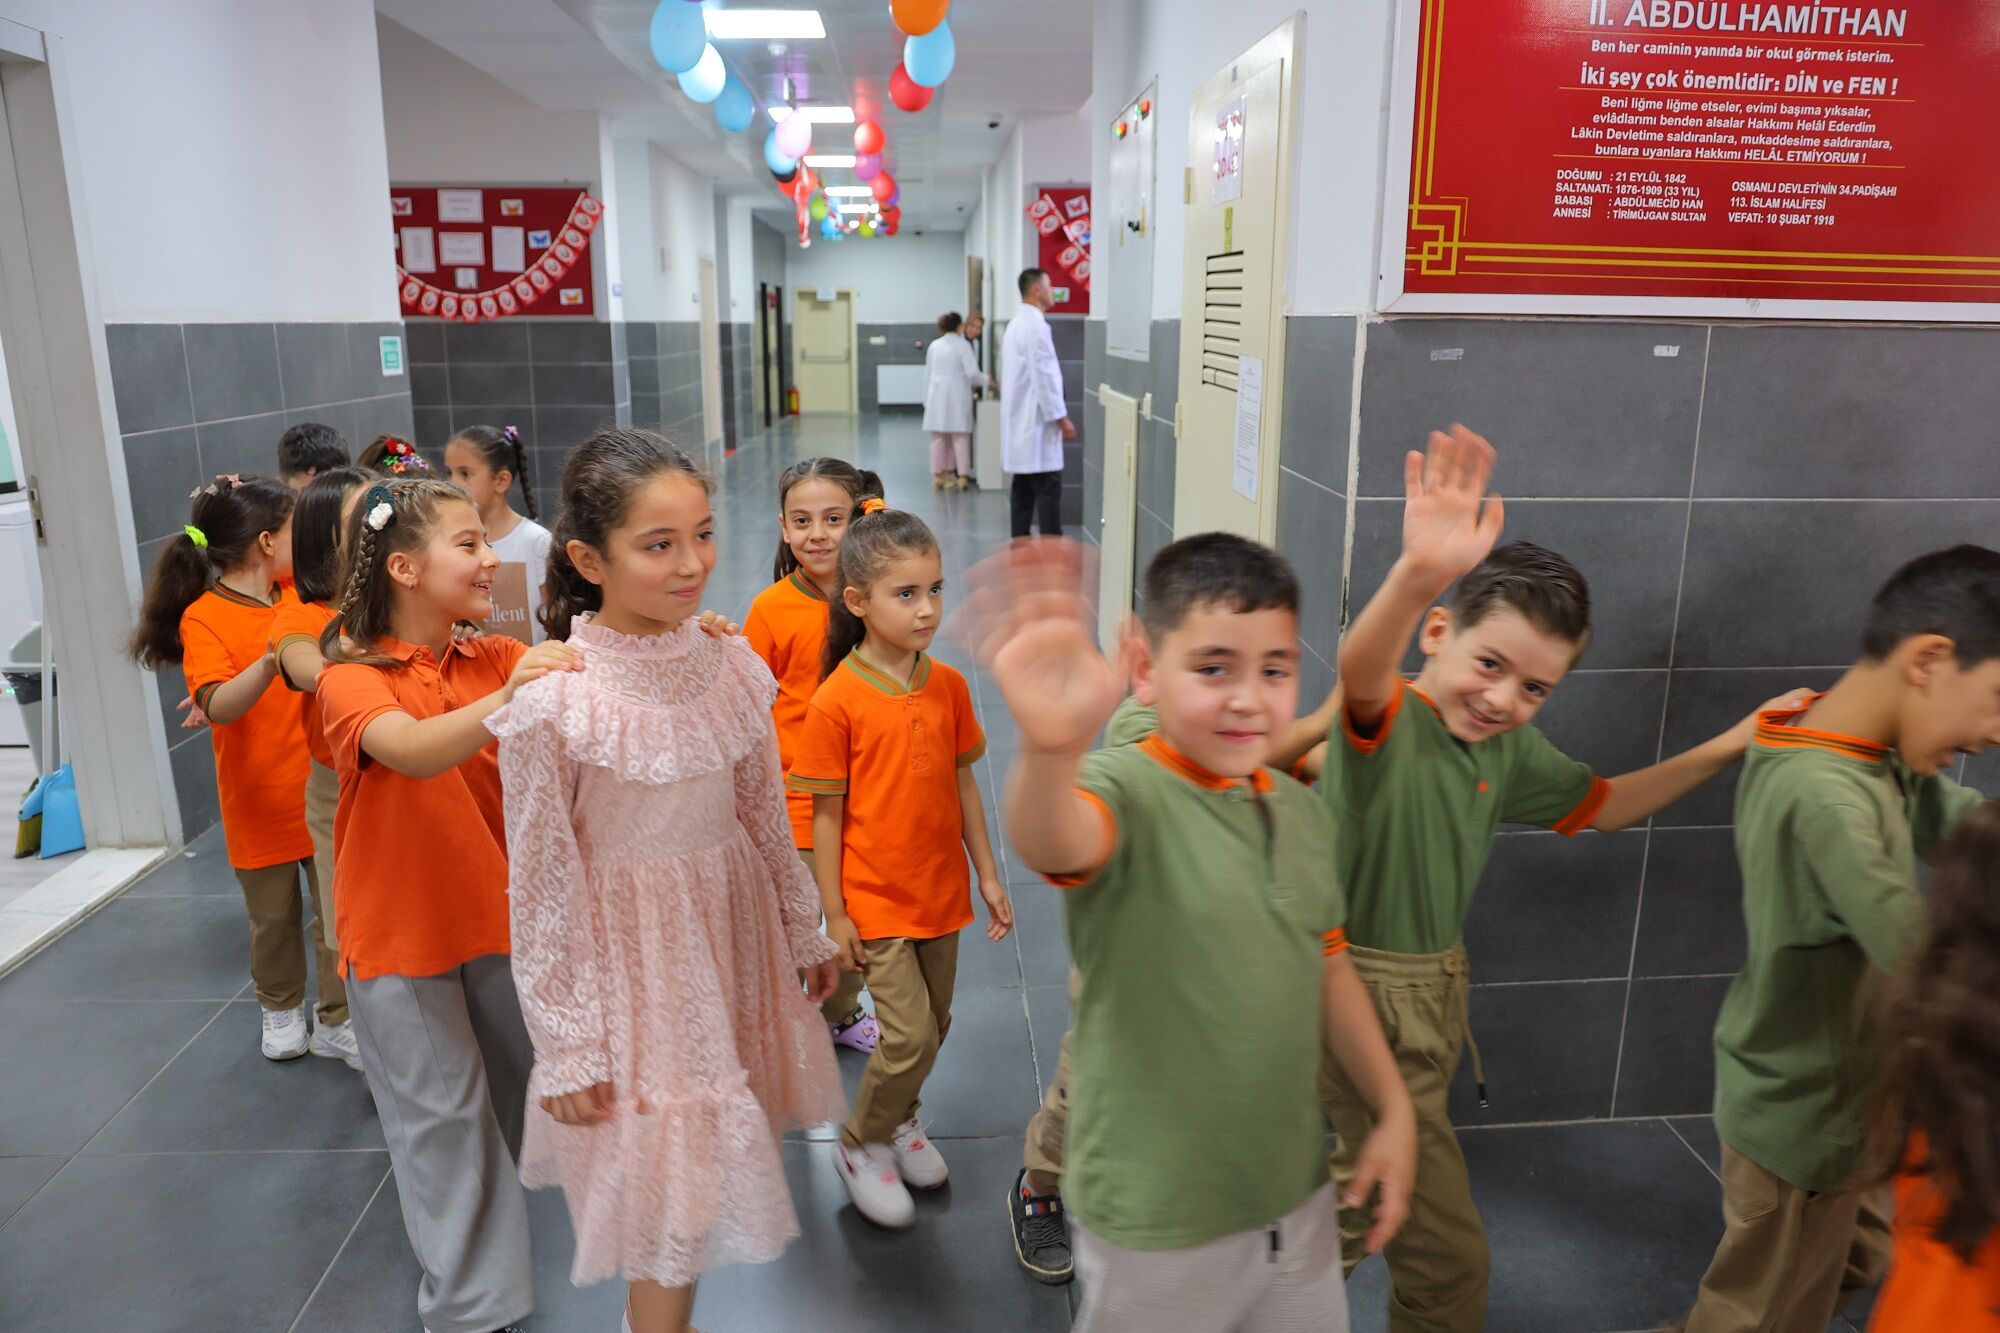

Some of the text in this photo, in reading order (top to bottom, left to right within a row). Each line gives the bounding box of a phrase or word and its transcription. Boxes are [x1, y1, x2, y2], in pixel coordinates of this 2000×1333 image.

[1589, 0, 1614, 26] II.
[1591, 39, 1894, 63] Ben her caminin yanında bir okul görmek isterim.
[1581, 61, 1605, 85] İki
[1609, 71, 1642, 90] şey
[1646, 70, 1679, 89] çok
[1683, 69, 1780, 91] önemlidir:
[1784, 70, 1818, 93] DİN
[1823, 80, 1844, 94] ve
[1848, 77, 1886, 95] FEN
[1601, 96, 1871, 118] Beni liğme liğme etseler, evimi başıma yıksalar,
[1593, 112, 1876, 133] evlâdlarımı benden alsalar Hakkımı Helâl Ederdim
[1571, 127, 1892, 150] Lâkin Devletime saldıranlara, mukaddesime saldıranlara,
[1595, 143, 1639, 156] bunlara
[1642, 146, 1692, 159] uyanlara
[1695, 147, 1741, 159] Hakkımı
[1744, 147, 1784, 161] HELÂL
[1787, 149, 1859, 163] ETMİYORUM
[1557, 168, 1602, 181] DOĞUMU
[1616, 172, 1626, 181] 21
[1629, 171, 1662, 183] EYLÜL
[1665, 173, 1686, 183] 1842
[1616, 184, 1662, 195] 1876-1909
[1664, 186, 1679, 197] (33
[1681, 187, 1700, 198] YIL)
[1732, 181, 1776, 193] OSMANLI
[1555, 195, 1593, 205] BABASI
[1614, 196, 1680, 208] ABDÜLMECİD
[1682, 199, 1703, 209] HAN
[1730, 195, 1826, 210] 113. İSLAM HALİFESİ
[1553, 206, 1591, 218] ANNESİ
[1613, 208, 1669, 220] TİRİMÜJGAN
[1671, 212, 1706, 221] SULTAN
[1728, 212, 1835, 226] VEFATI: 10 ŞUBAT 1918
